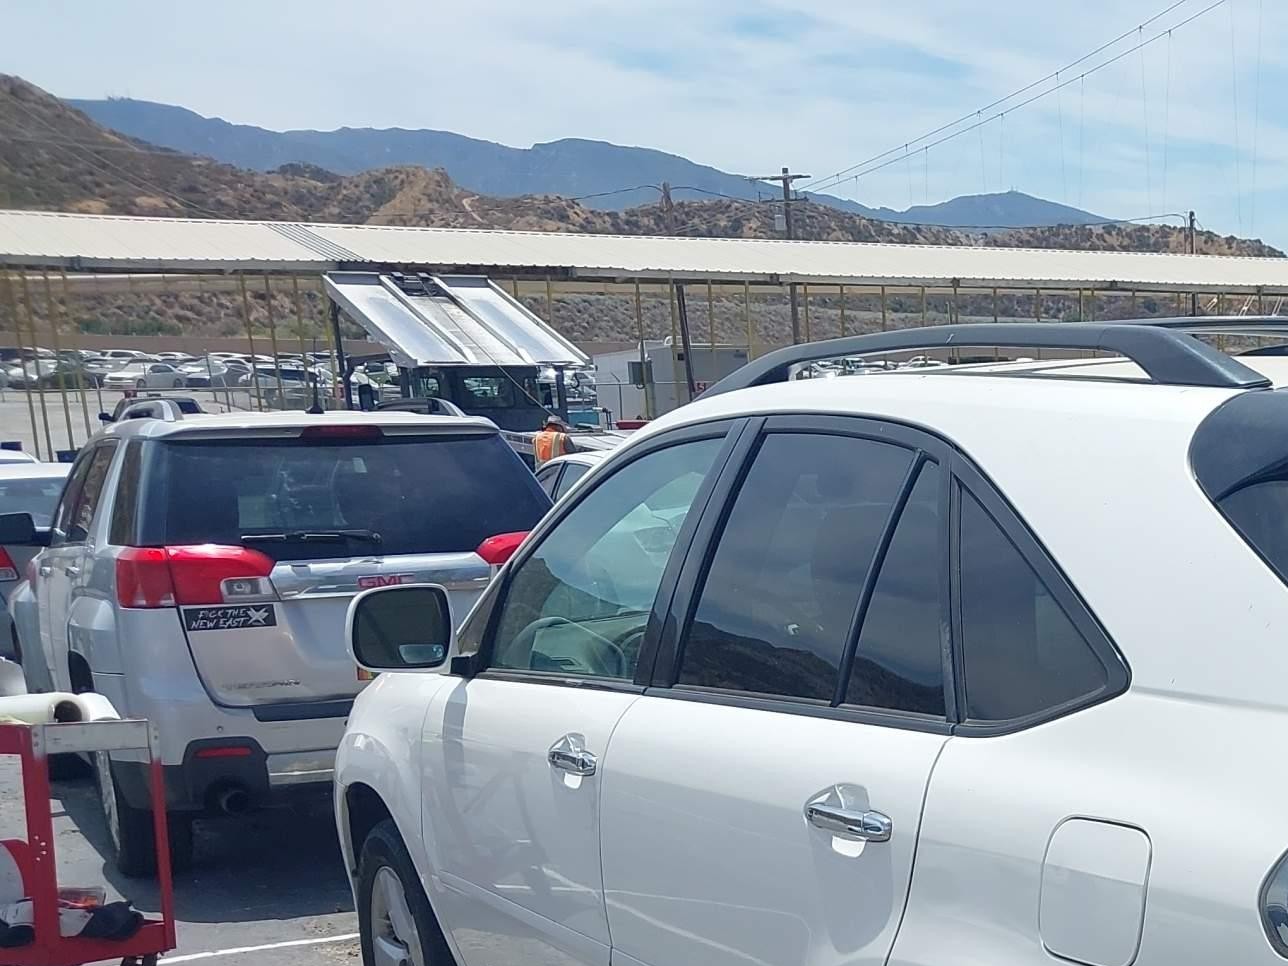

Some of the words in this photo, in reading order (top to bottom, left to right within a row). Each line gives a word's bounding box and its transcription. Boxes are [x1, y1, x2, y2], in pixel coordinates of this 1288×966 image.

[357, 573, 416, 588] GMC
[225, 608, 247, 618] THE
[191, 619, 217, 630] NEW
[219, 617, 250, 628] EAST
